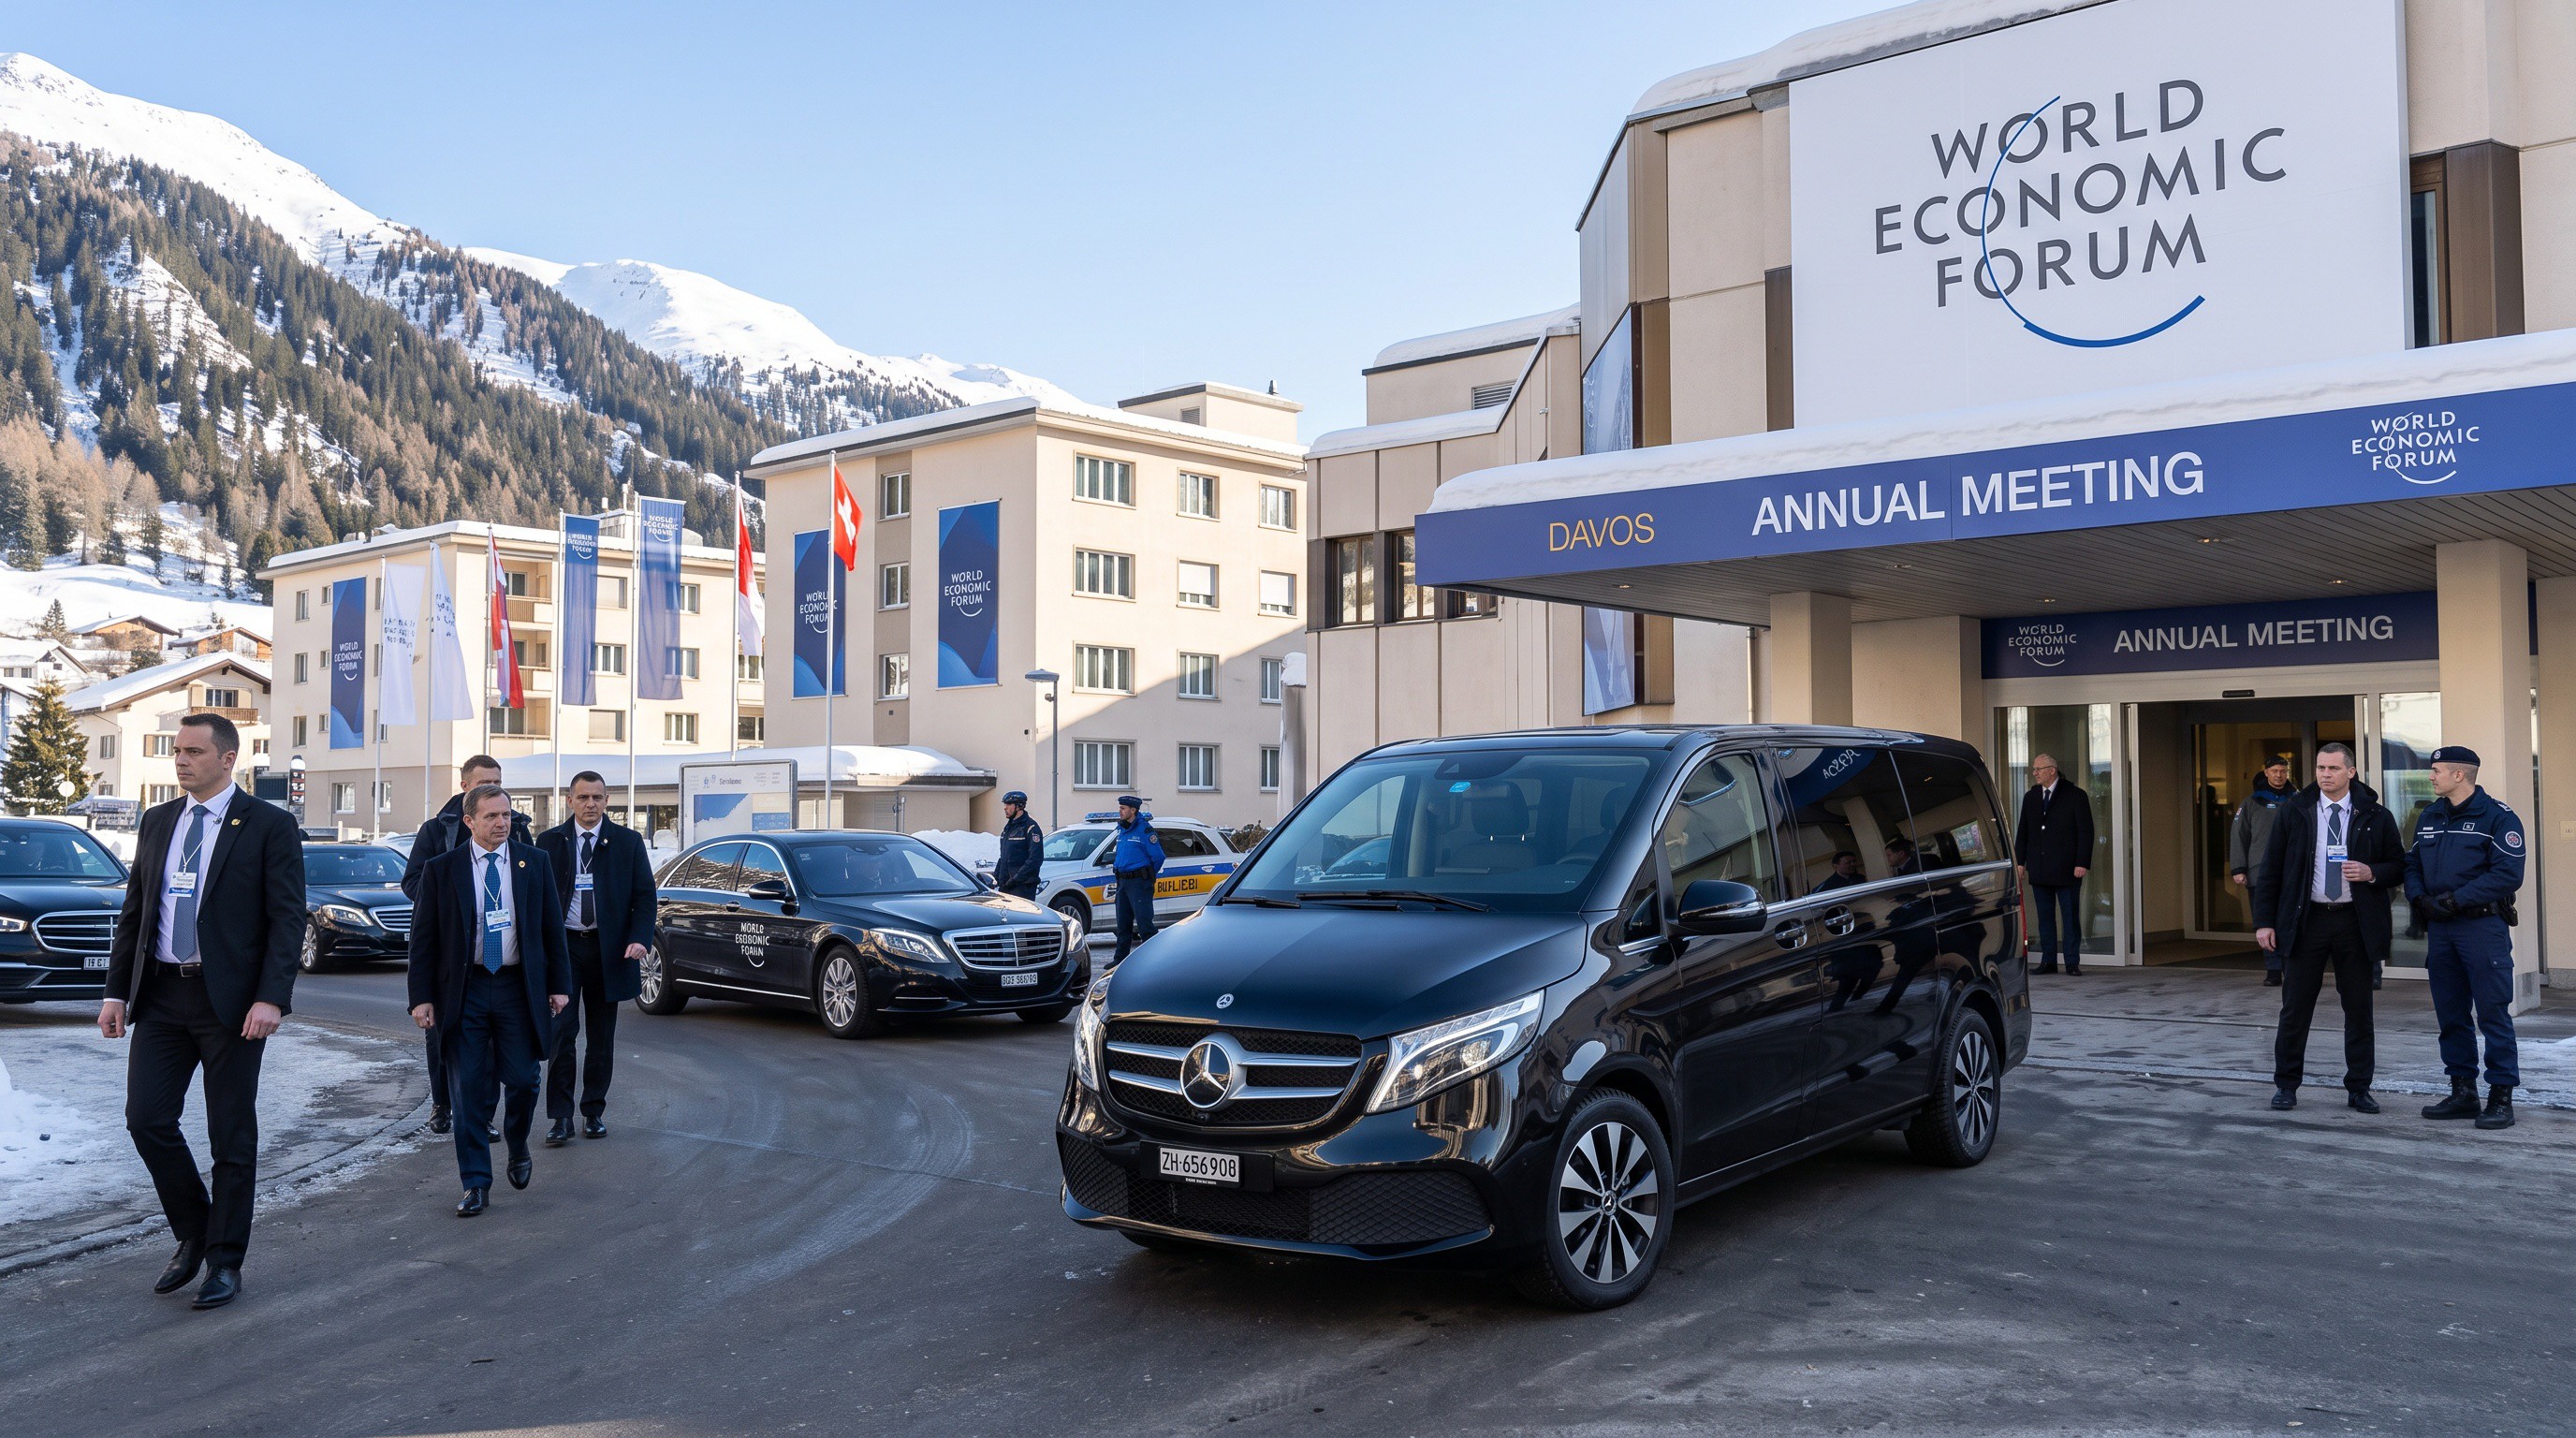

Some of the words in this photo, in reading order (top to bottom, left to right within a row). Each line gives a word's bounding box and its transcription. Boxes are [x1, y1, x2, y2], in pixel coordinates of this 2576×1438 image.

[1931, 80, 2203, 179] WORLD
[1875, 127, 2287, 255] ECONOMIC
[1937, 213, 2206, 308] FORUM
[2371, 411, 2456, 434] WORLD
[2351, 426, 2480, 455] ECONOMIC
[2372, 448, 2457, 471] FORUM
[1549, 512, 1655, 551] DAVOS
[1751, 480, 1945, 536] ANNUAL
[1962, 451, 2203, 516] MEETING
[951, 569, 983, 583] WORLD
[806, 591, 829, 602] WORL
[944, 580, 991, 596] ECONOMIC
[799, 599, 838, 614] ECONOC
[951, 594, 983, 607] FORUM
[2018, 624, 2065, 636] WORLD
[2113, 624, 2238, 653] ANNUAL
[2247, 615, 2393, 646] MEETING
[2008, 634, 2077, 647] ECONOMIC
[2020, 646, 2065, 656] FORUM
